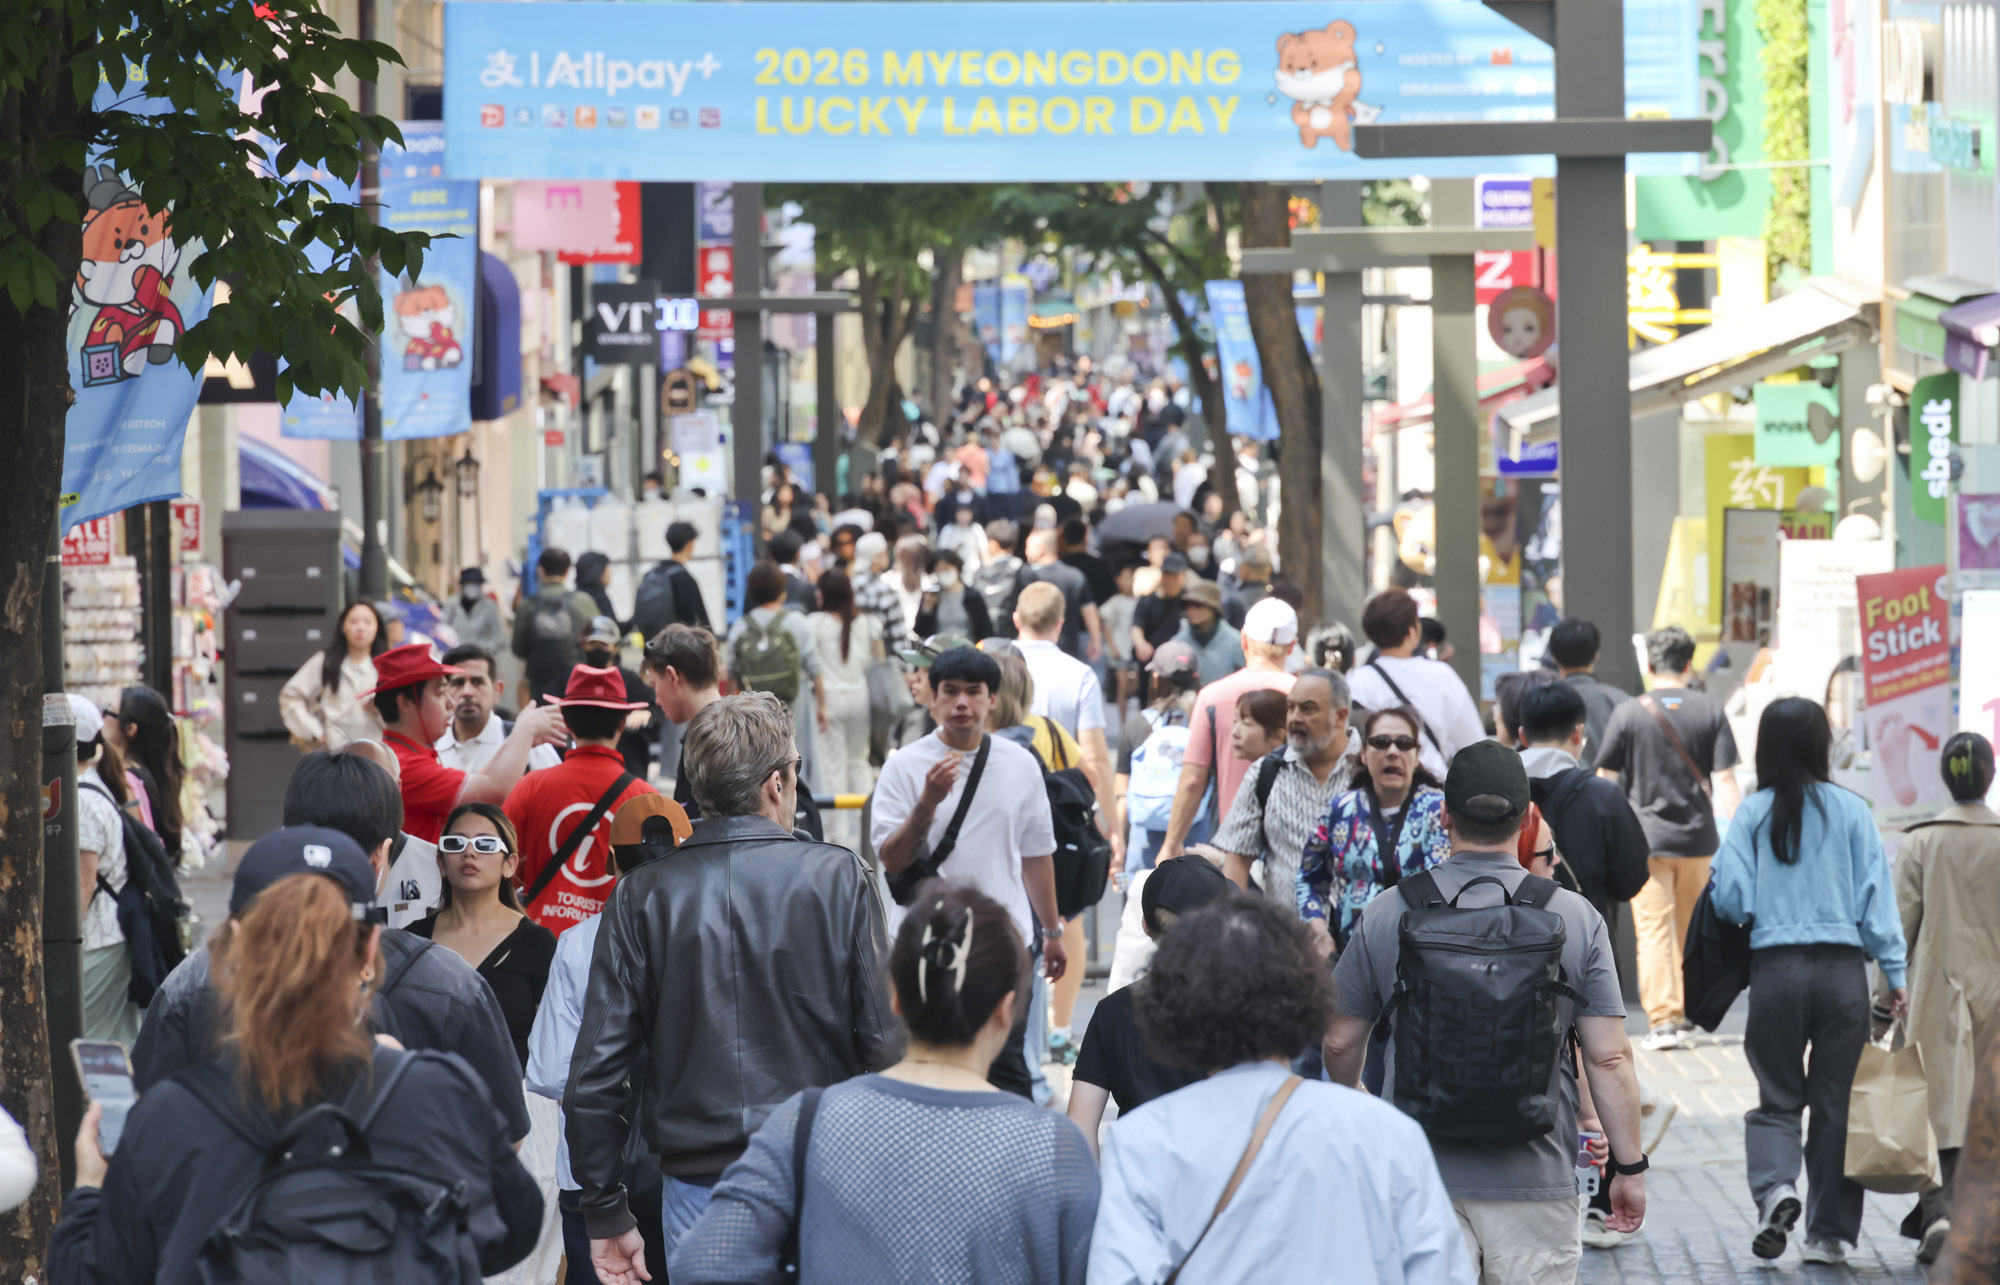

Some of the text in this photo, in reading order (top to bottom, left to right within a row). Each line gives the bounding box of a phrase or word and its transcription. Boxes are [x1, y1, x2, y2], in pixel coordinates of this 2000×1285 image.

[755, 48, 1241, 86] 2026 MYEONGDONG
[755, 96, 930, 135] LUCKY
[943, 95, 1115, 135] LABOR
[1130, 95, 1241, 134] DAY
[1920, 398, 1952, 499] sbedt
[67, 517, 108, 543] ALE
[1866, 585, 1932, 628] Foot
[1868, 616, 1942, 663] Stick
[557, 891, 605, 912] TOURIST
